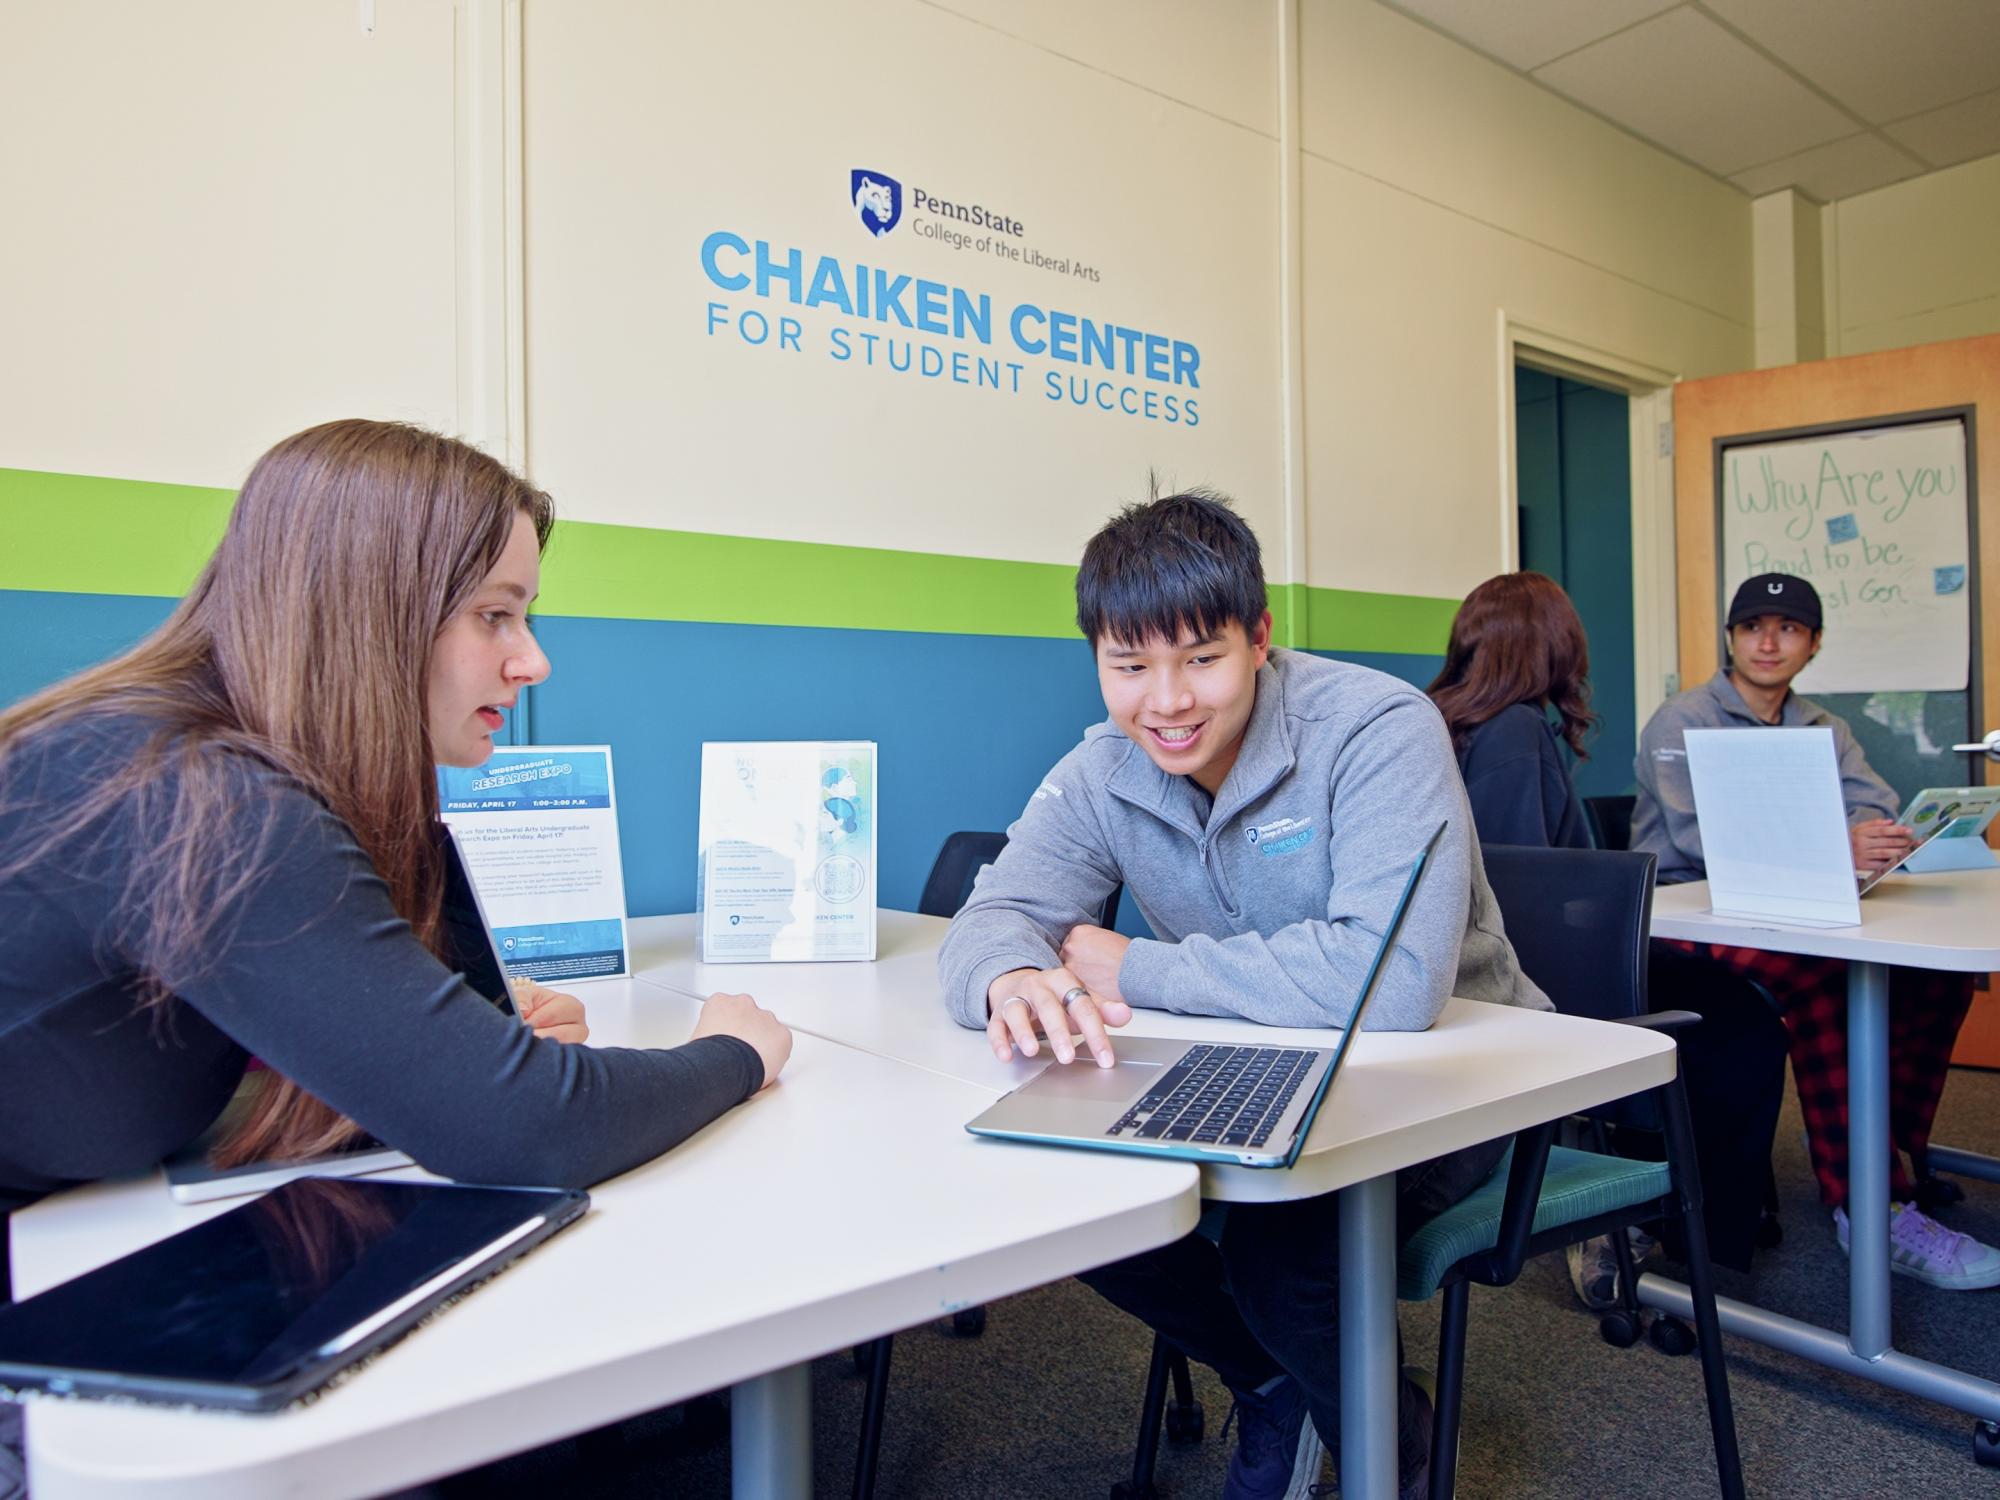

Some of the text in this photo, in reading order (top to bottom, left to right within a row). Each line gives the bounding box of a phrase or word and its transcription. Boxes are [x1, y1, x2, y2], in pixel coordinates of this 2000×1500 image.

[913, 187, 1025, 238] PennState
[913, 218, 1101, 283] College of the Liberal Arts
[701, 231, 1201, 389] CHAIKEN CENTER
[708, 303, 1201, 426] FOR STUDENT SUCCESS
[1732, 455, 1814, 541] Why
[1815, 450, 1889, 511] Are
[1884, 464, 1957, 524] you
[1824, 545, 1850, 570] to
[1861, 536, 1904, 566] be
[472, 763, 573, 791] RESEARCH EXPO
[488, 759, 554, 775] UNDERGRADUATE
[448, 801, 480, 809] FRIDAY,
[483, 834, 500, 842] Expo
[540, 824, 590, 832] Undergraduate
